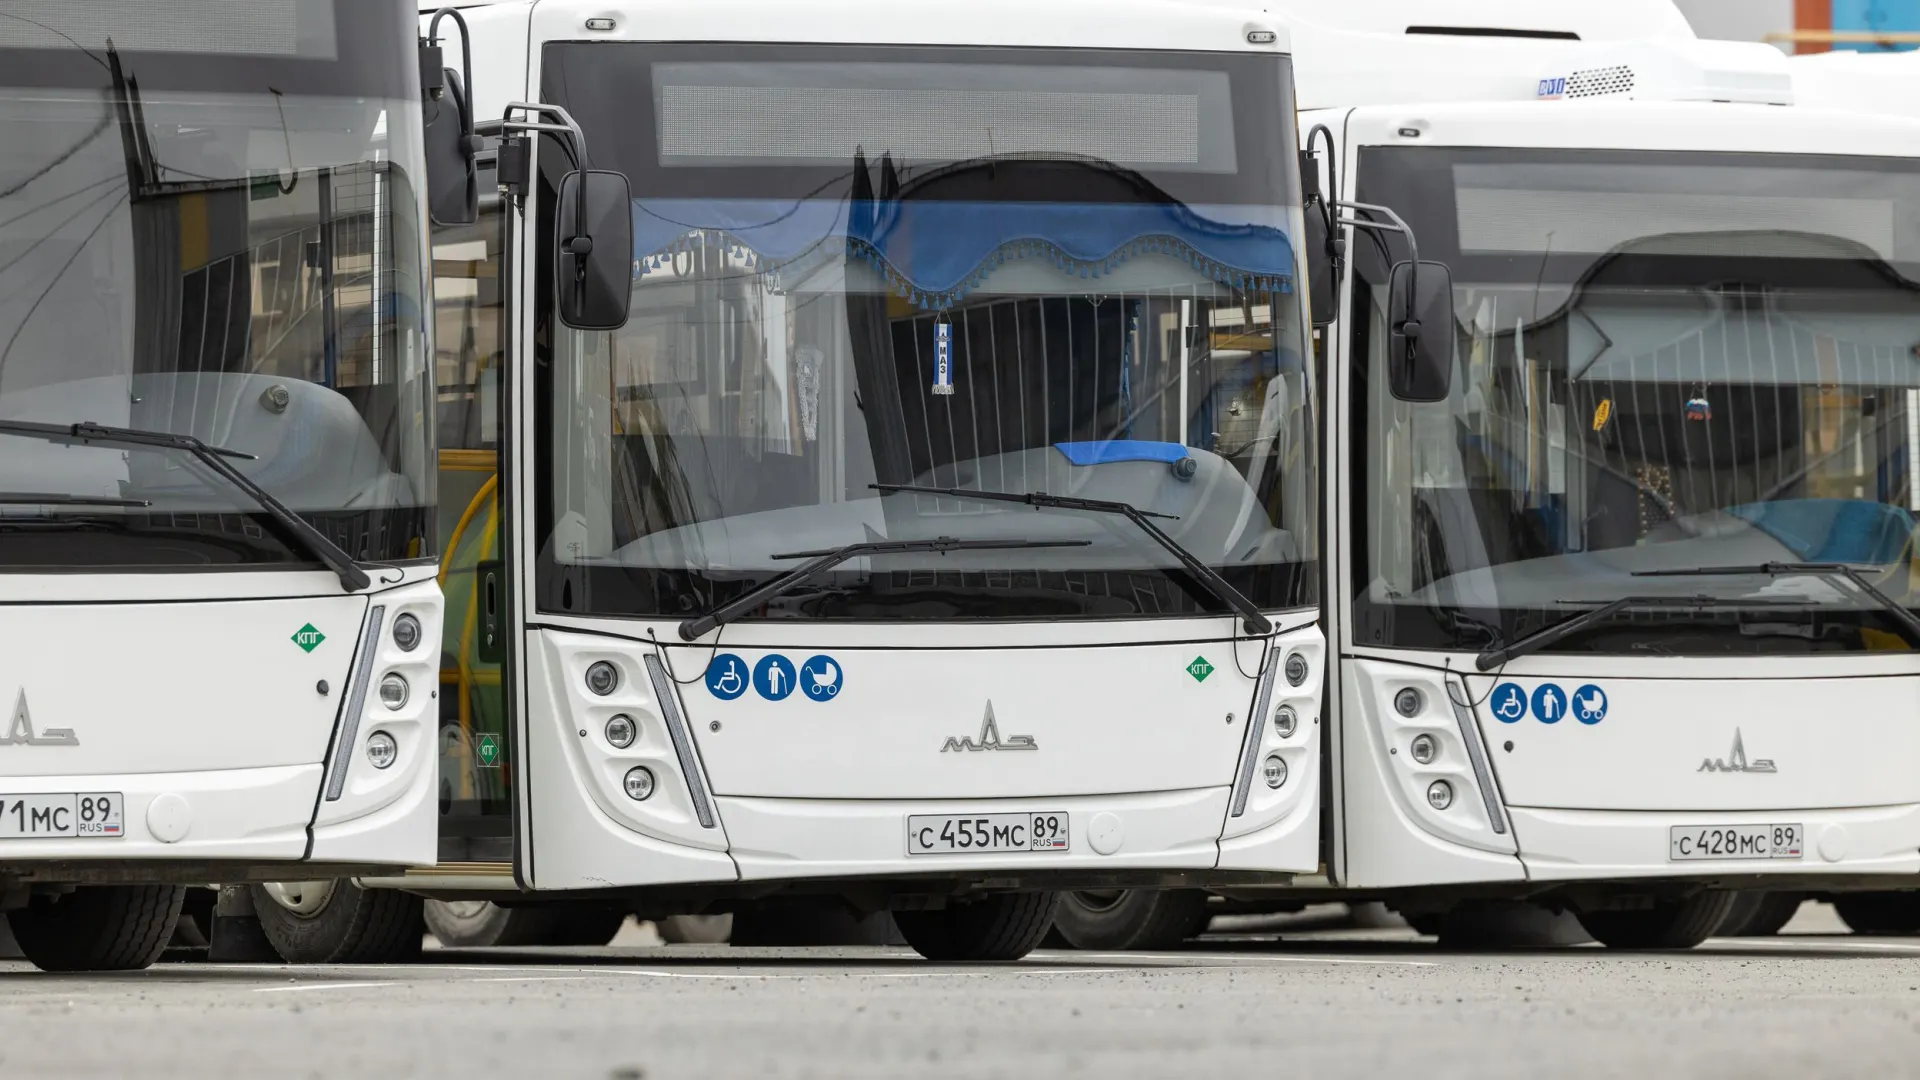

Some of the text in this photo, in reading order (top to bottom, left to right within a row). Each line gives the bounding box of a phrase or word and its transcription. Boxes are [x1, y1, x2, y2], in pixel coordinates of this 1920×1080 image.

[297, 632, 320, 644] КПГ
[1191, 664, 1210, 675] КПГ
[81, 797, 111, 822] 89
[80, 823, 103, 833] RUS
[1033, 816, 1059, 838] 89
[1033, 838, 1052, 847] RUS
[1773, 827, 1795, 847] 89
[1772, 847, 1789, 855] RUS
